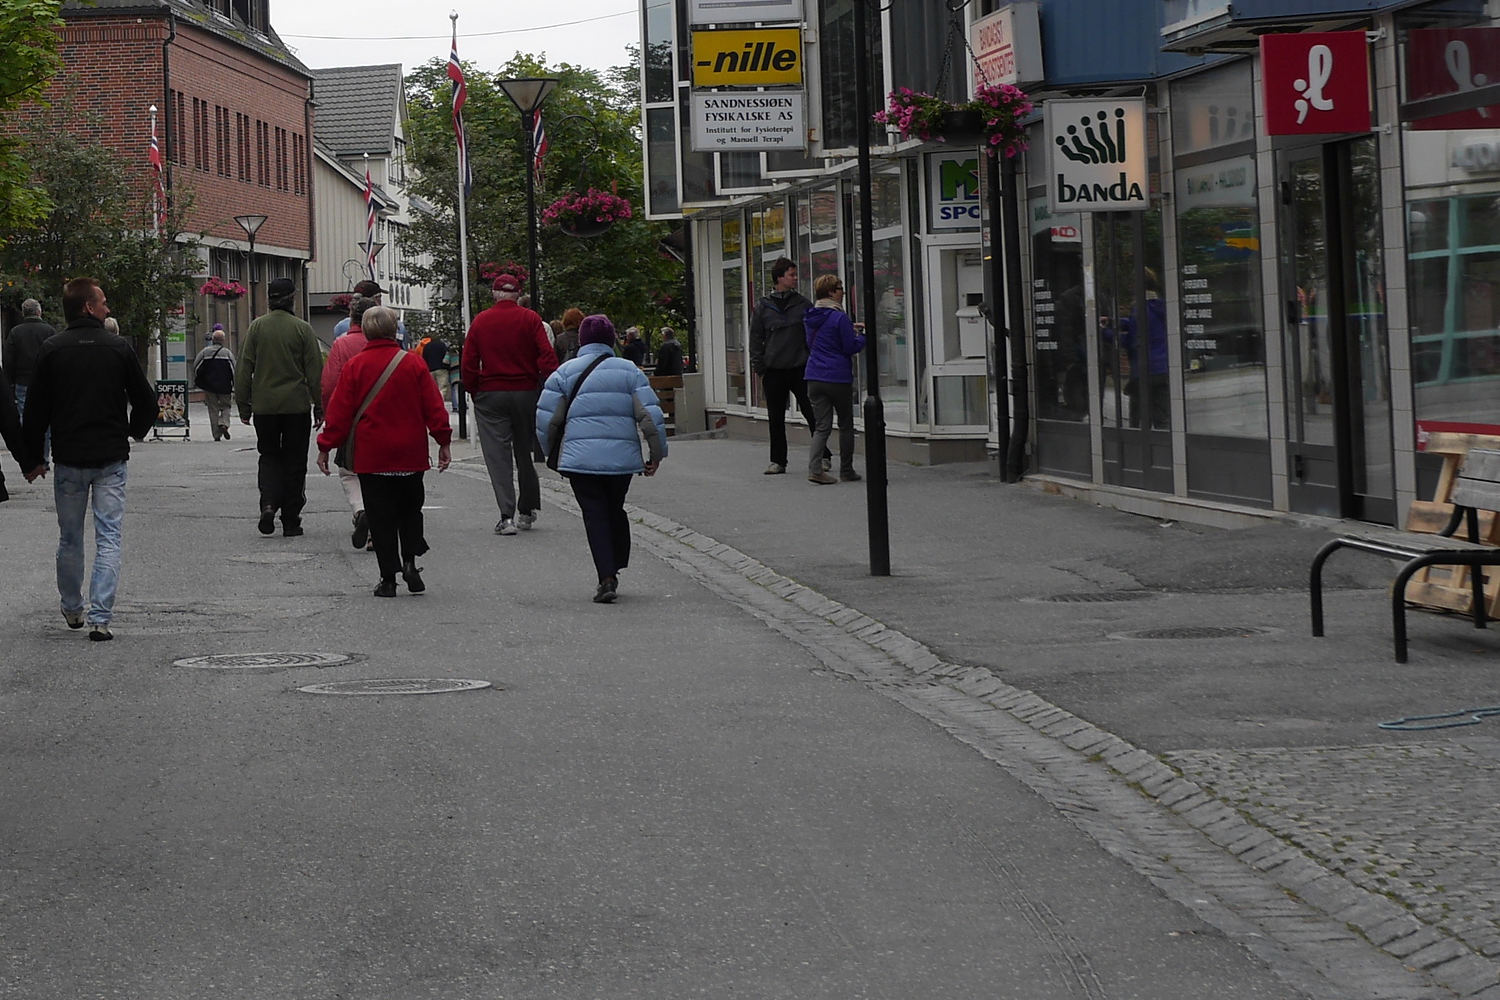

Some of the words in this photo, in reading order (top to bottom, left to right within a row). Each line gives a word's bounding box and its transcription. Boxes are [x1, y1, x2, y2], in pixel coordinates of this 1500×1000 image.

[705, 111, 771, 122] FYSIKALSKE
[778, 111, 793, 121] AS
[706, 126, 737, 134] Institutt
[755, 126, 794, 135] Fysioterapi
[730, 136, 759, 144] Manuell
[762, 136, 784, 144] Terapi
